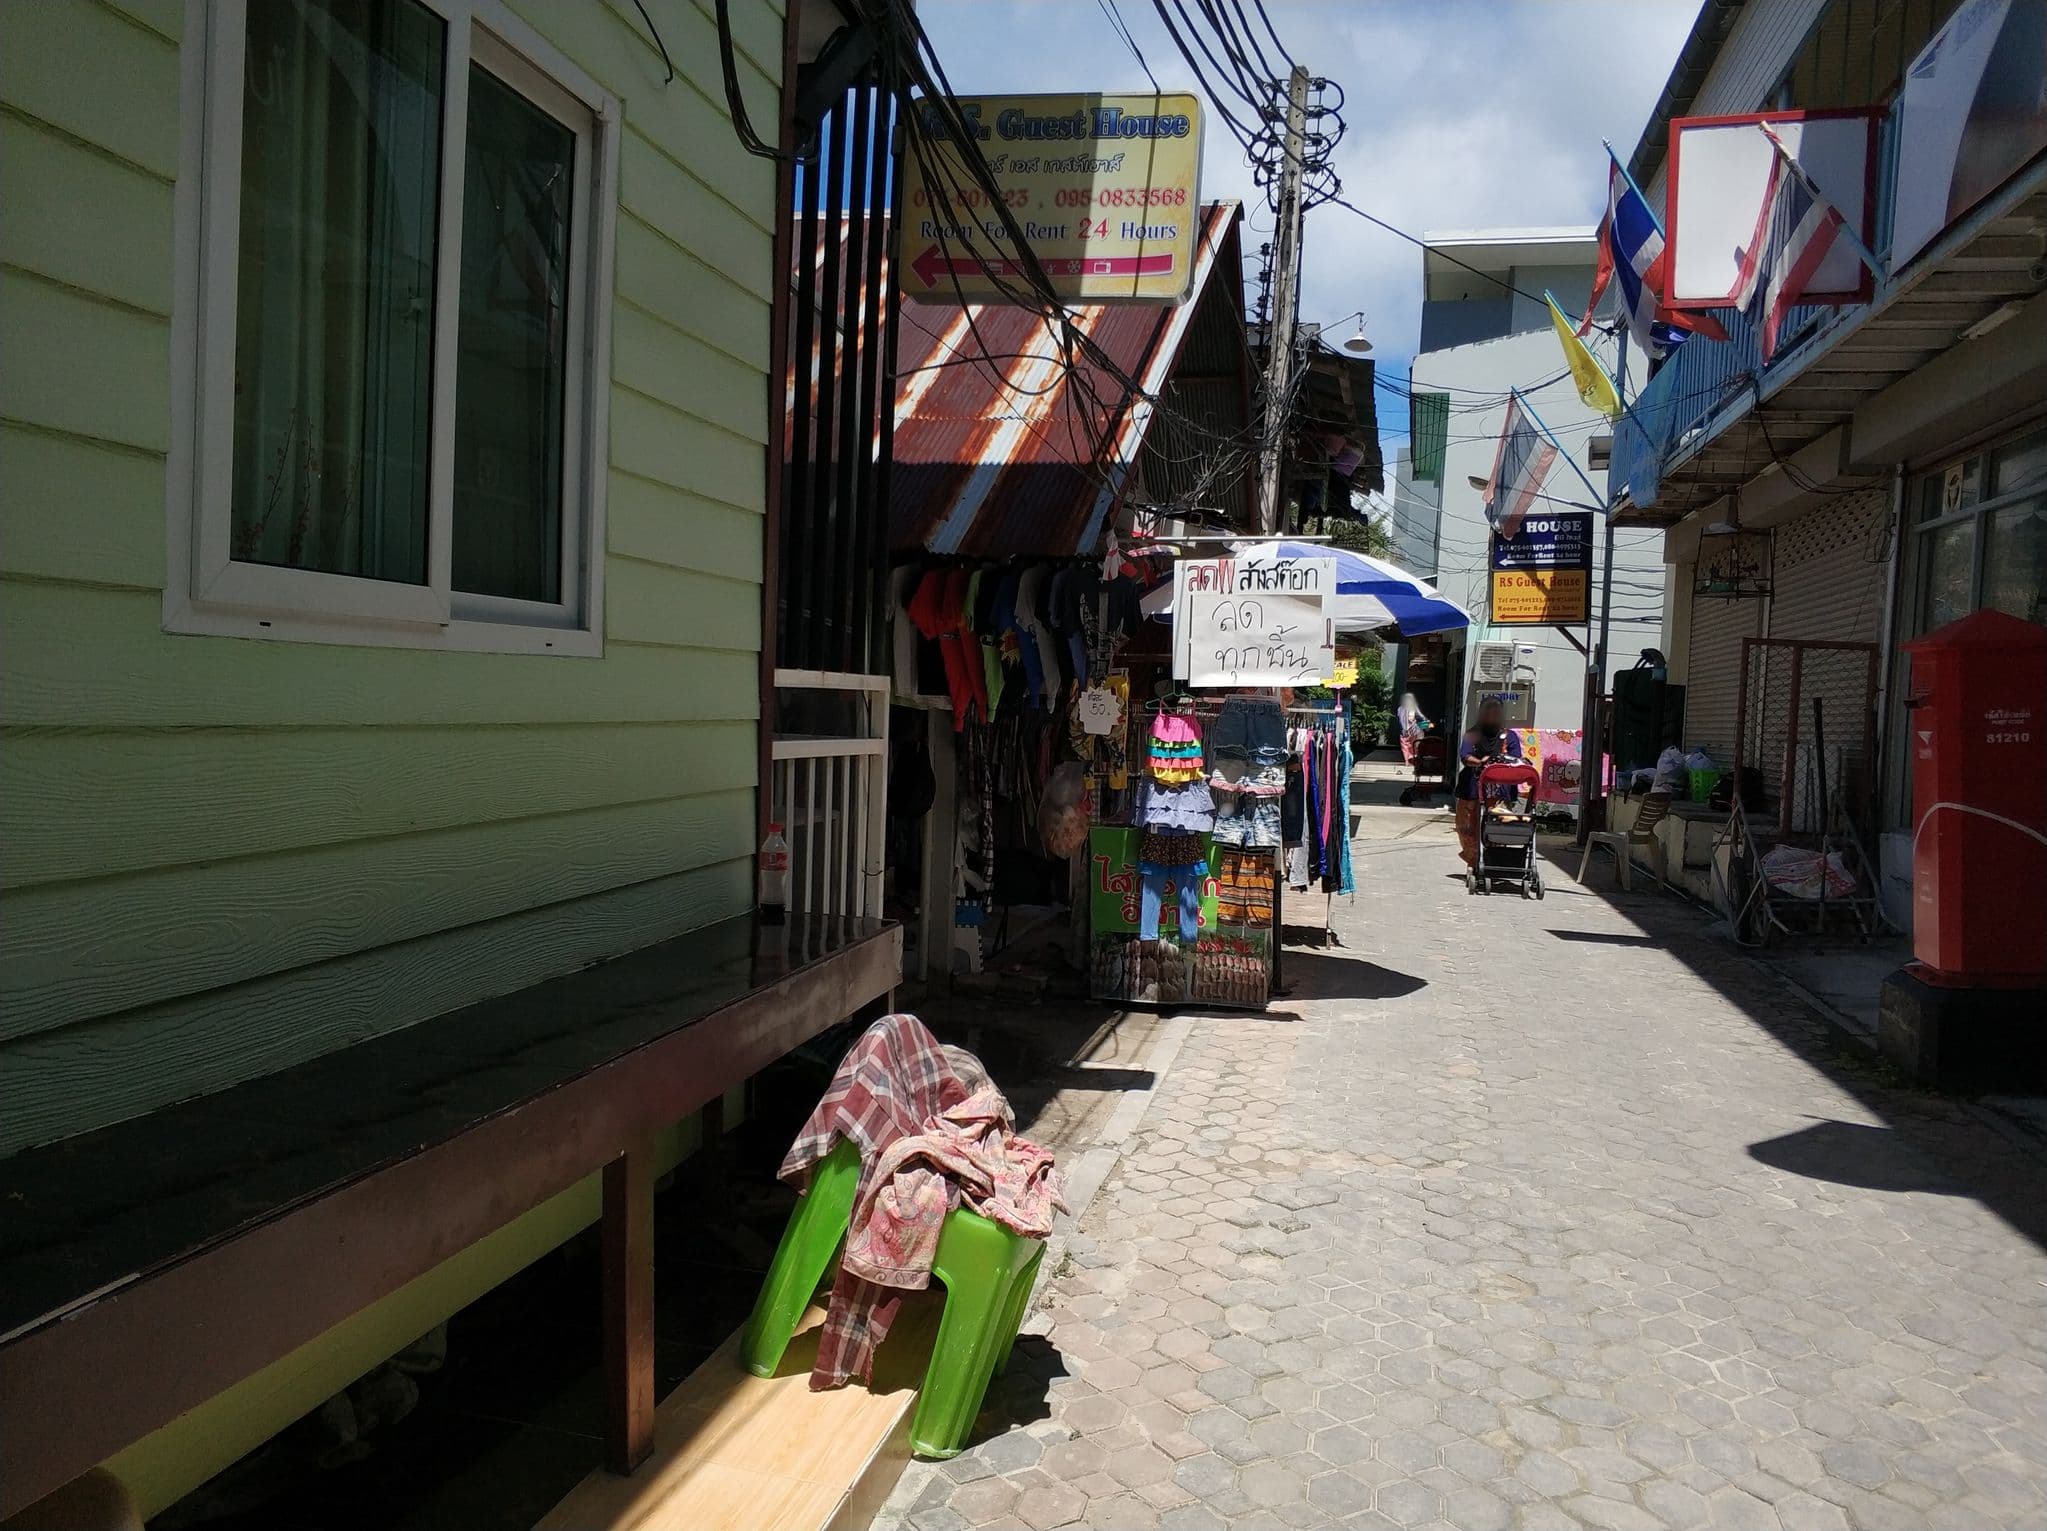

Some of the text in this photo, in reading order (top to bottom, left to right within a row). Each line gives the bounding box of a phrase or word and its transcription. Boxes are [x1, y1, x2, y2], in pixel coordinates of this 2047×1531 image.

[997, 108, 1088, 140] Guest
[1089, 106, 1190, 140] House
[1054, 188, 1187, 210] 095-0833568
[1025, 222, 1069, 240] Rent
[1077, 217, 1111, 241] 24
[1120, 221, 1178, 241] Hours
[1526, 520, 1582, 534] HOUSE
[1499, 575, 1581, 588] RS Guest House
[1212, 600, 1264, 632] ลด
[1986, 732, 2031, 744] 81210
